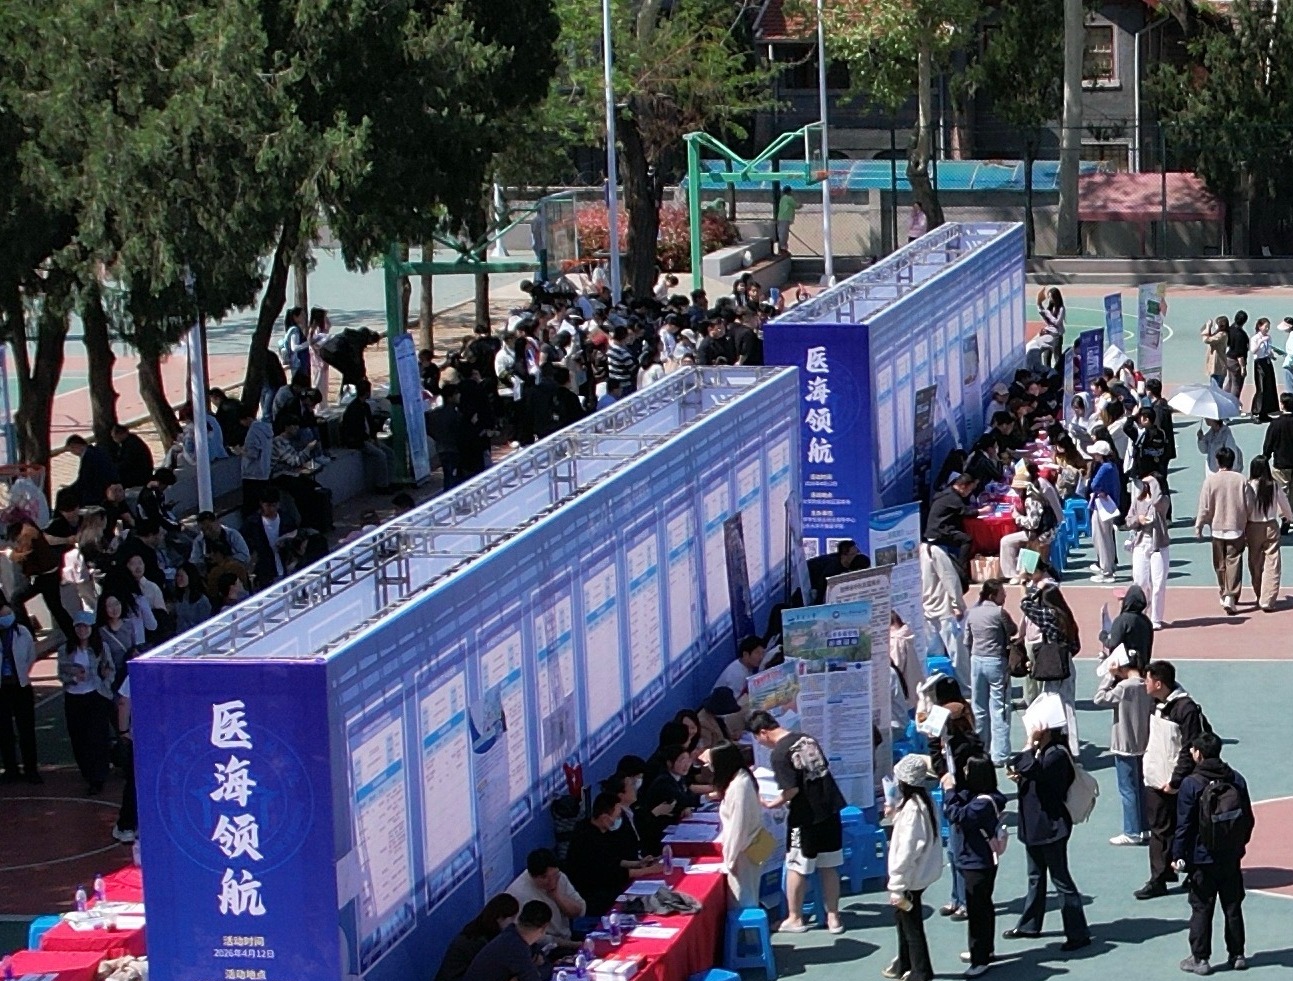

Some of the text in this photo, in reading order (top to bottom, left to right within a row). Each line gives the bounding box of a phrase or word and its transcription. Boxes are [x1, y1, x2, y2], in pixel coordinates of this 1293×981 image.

[804, 346, 834, 464] 医海领航
[209, 700, 267, 916] 医海领航
[222, 935, 265, 947] 活动时间
[213, 948, 275, 959] 2026年4月12日
[224, 968, 267, 980] 活动地点
